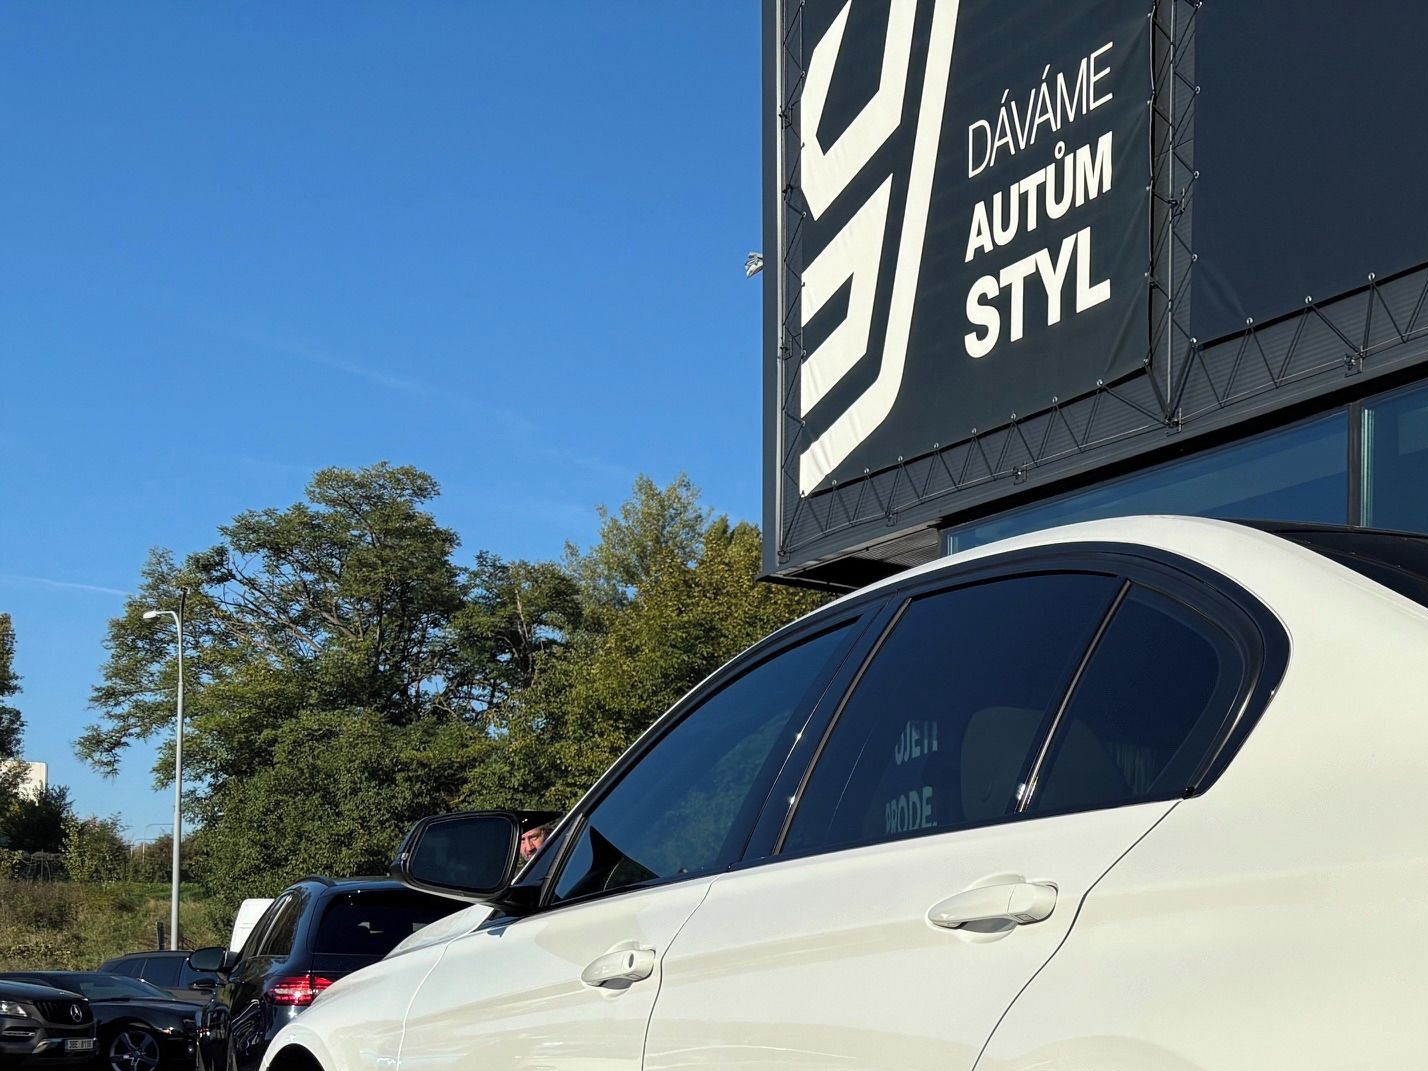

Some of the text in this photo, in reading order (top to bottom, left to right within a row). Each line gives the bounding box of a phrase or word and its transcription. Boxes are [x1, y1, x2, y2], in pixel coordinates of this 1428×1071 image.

[968, 42, 1113, 178] DÁVÁME
[965, 131, 1112, 262] AUTŮM
[965, 226, 1111, 358] STYL
